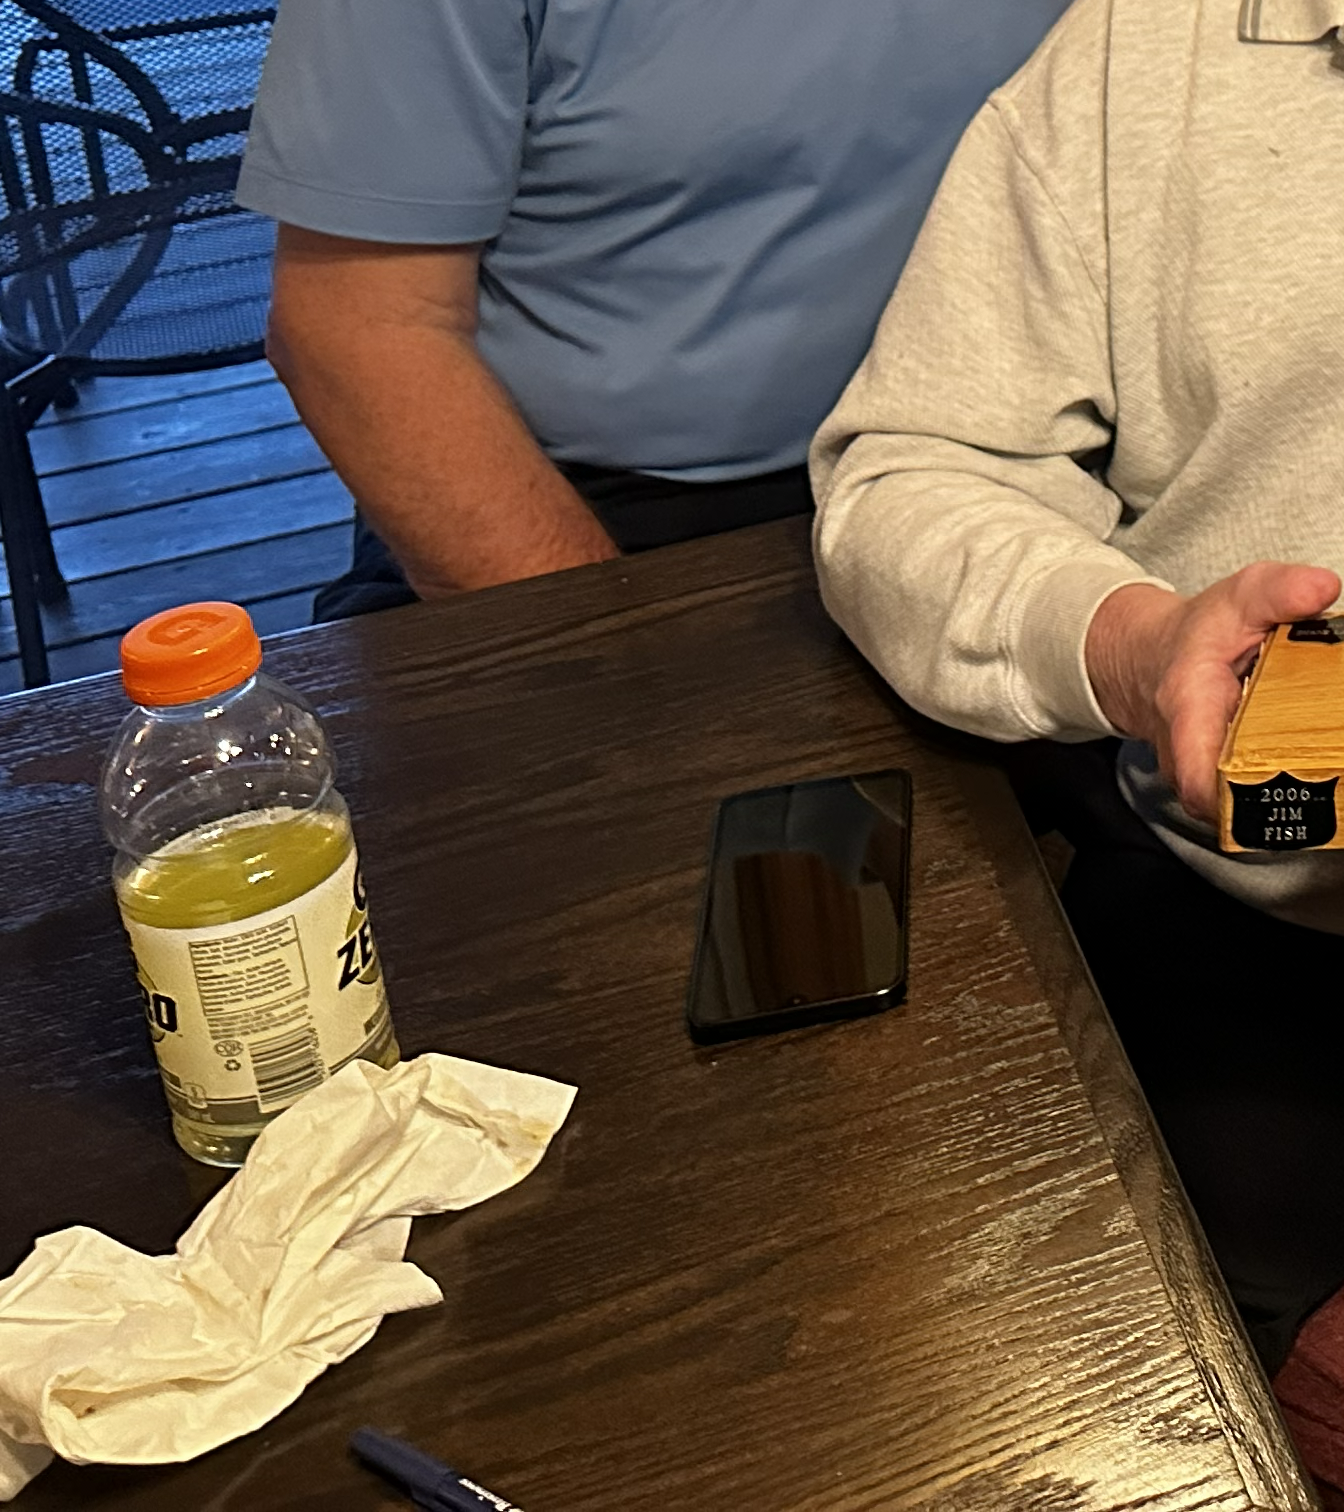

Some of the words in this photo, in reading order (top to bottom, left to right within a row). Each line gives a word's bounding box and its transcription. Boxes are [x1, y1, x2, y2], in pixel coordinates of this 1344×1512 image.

[1260, 787, 1312, 803] 2006
[1267, 806, 1303, 822] JIM
[1263, 825, 1308, 841] FISH
